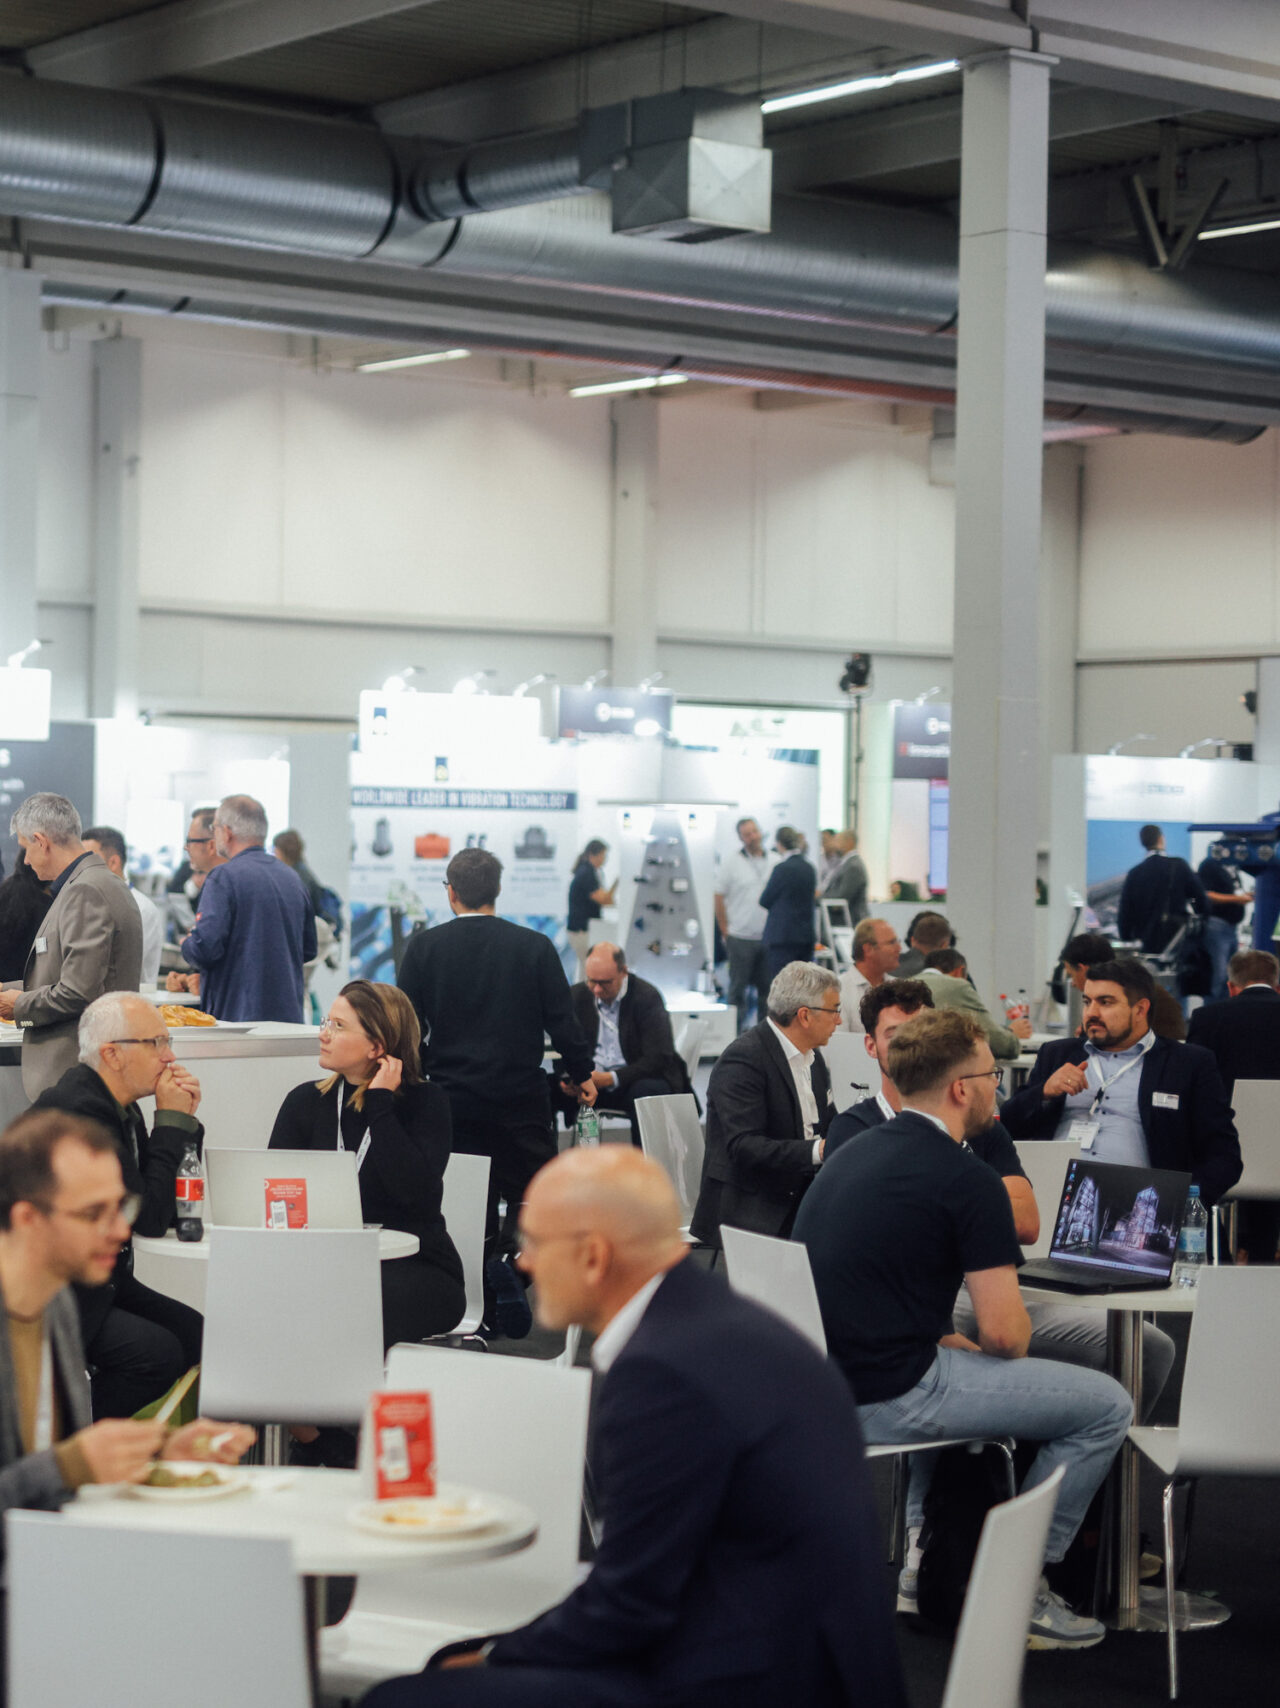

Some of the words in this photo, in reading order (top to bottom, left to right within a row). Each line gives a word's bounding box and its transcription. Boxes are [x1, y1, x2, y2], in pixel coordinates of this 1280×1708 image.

[353, 789, 408, 804] WORLDWIDE
[411, 790, 446, 805] LEADER
[448, 791, 460, 806] IN
[461, 791, 508, 807] VIBRATION
[511, 792, 569, 809] TECHNOLOGY
